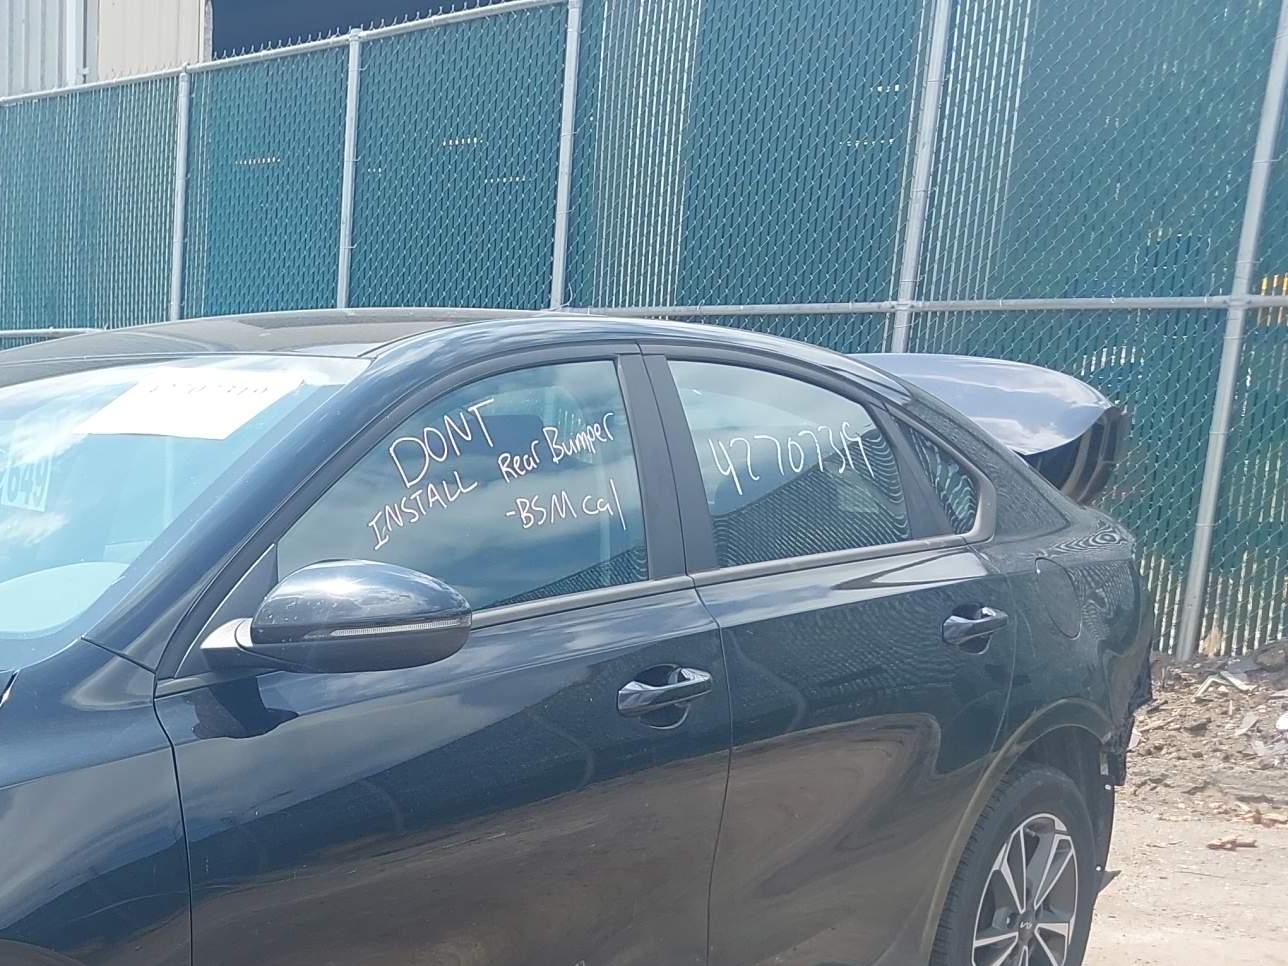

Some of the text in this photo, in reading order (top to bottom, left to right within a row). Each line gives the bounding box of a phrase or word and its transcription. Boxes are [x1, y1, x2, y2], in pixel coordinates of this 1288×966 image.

[389, 398, 495, 488] DONT
[497, 412, 615, 483] Rear Bumper
[709, 422, 875, 496] 42707319
[368, 471, 478, 550] INSTALL
